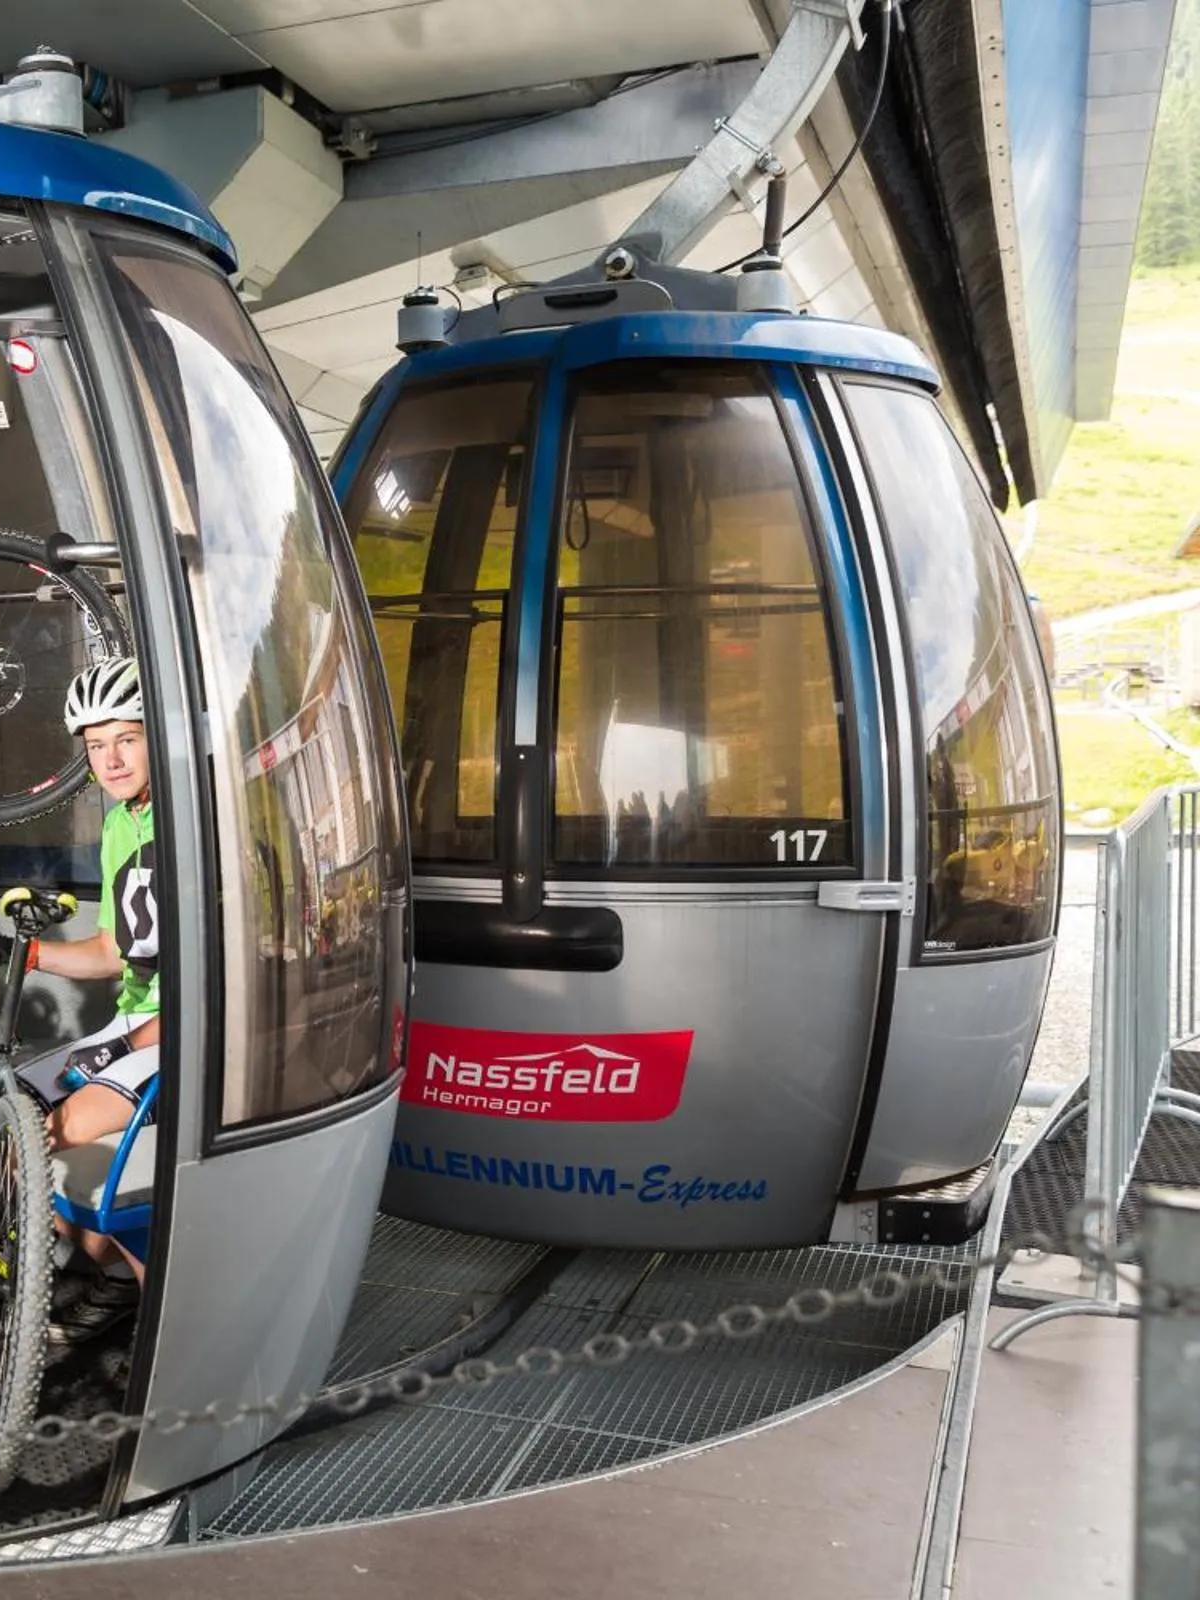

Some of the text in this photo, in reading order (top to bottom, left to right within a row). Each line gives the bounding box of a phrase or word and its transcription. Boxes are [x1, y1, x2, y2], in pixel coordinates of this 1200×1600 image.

[770, 830, 828, 862] 117
[427, 1052, 641, 1094] Nassfeld
[423, 1086, 552, 1115] Hermagor
[389, 1141, 768, 1211] ILLENNIUM-Express
